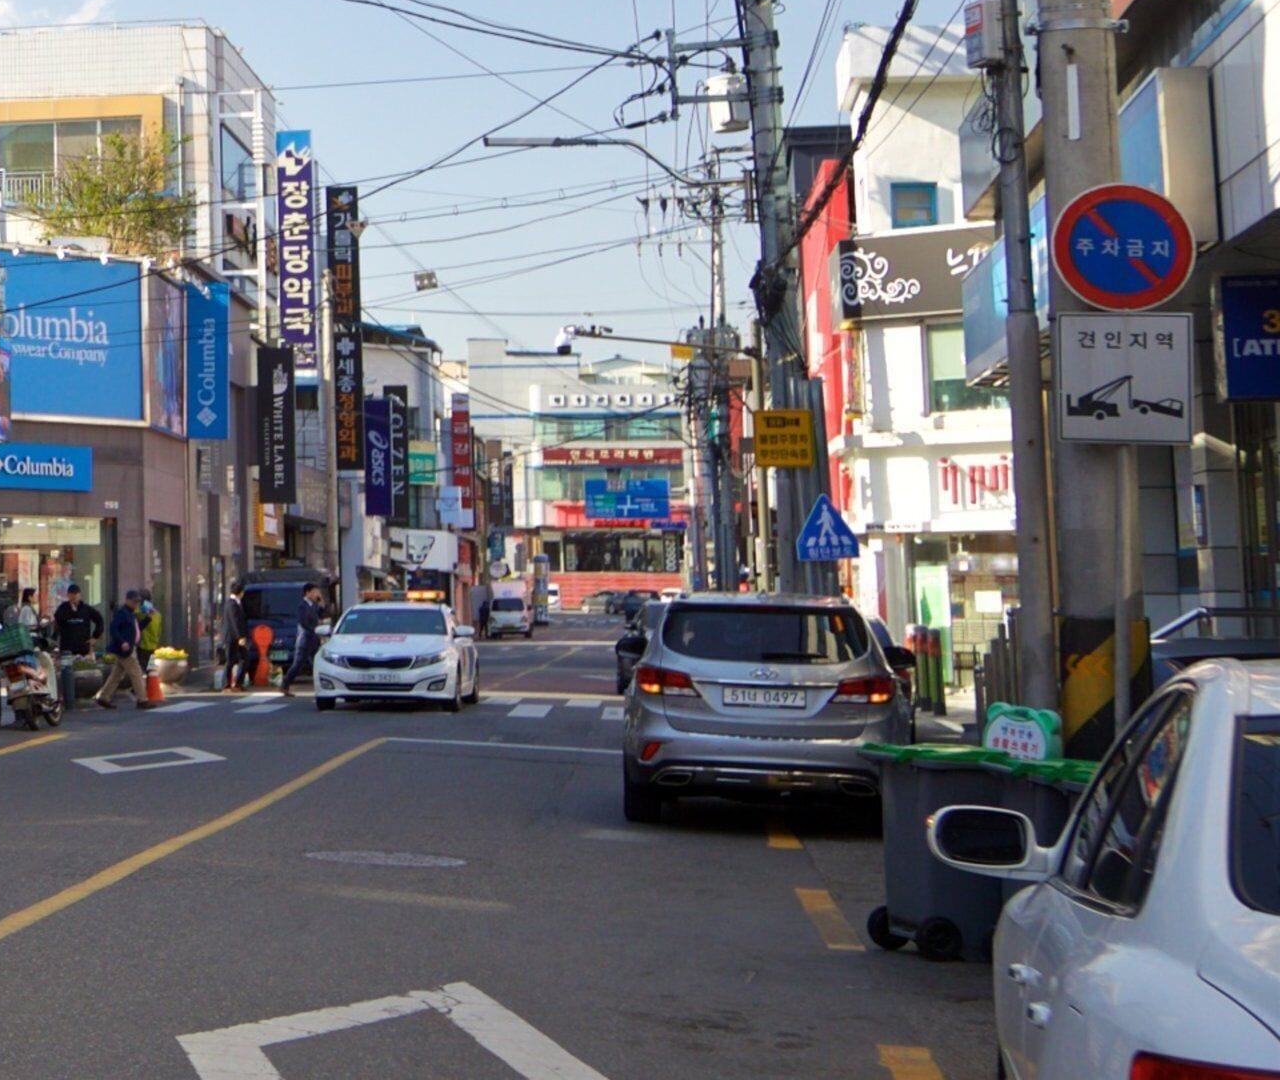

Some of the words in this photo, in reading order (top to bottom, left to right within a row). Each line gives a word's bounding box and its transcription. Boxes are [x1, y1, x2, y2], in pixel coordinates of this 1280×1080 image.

[1076, 237, 1170, 258] 주차금지
[1077, 330, 1174, 350] 견인지역
[48, 341, 110, 367] Company
[197, 317, 215, 407] Columbia
[273, 395, 285, 441] WHITE
[3, 453, 75, 478] Columbia
[273, 444, 285, 488] LABEL
[371, 452, 386, 487] asics
[763, 690, 799, 703] 0497
